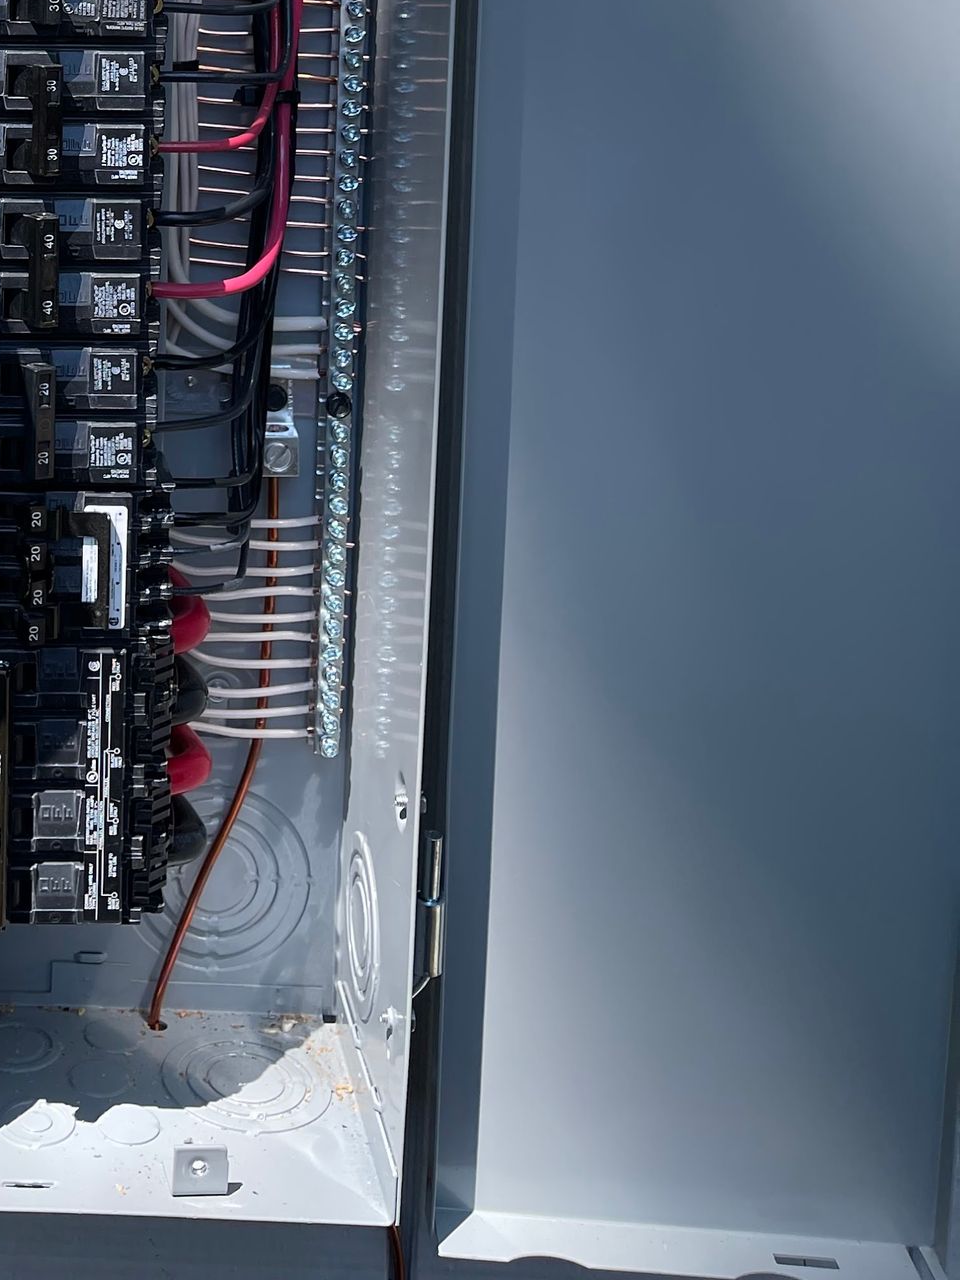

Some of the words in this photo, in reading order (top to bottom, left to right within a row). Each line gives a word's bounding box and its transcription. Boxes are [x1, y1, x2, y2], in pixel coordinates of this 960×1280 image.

[47, 79, 56, 92] 30
[47, 148, 58, 161] 30
[44, 234, 54, 249] 40
[42, 300, 53, 315] 40
[40, 382, 49, 396] 20
[38, 451, 49, 465] 20
[31, 511, 42, 528] 20
[30, 546, 41, 562] 20
[32, 589, 43, 606] 20
[29, 625, 39, 642] 20
